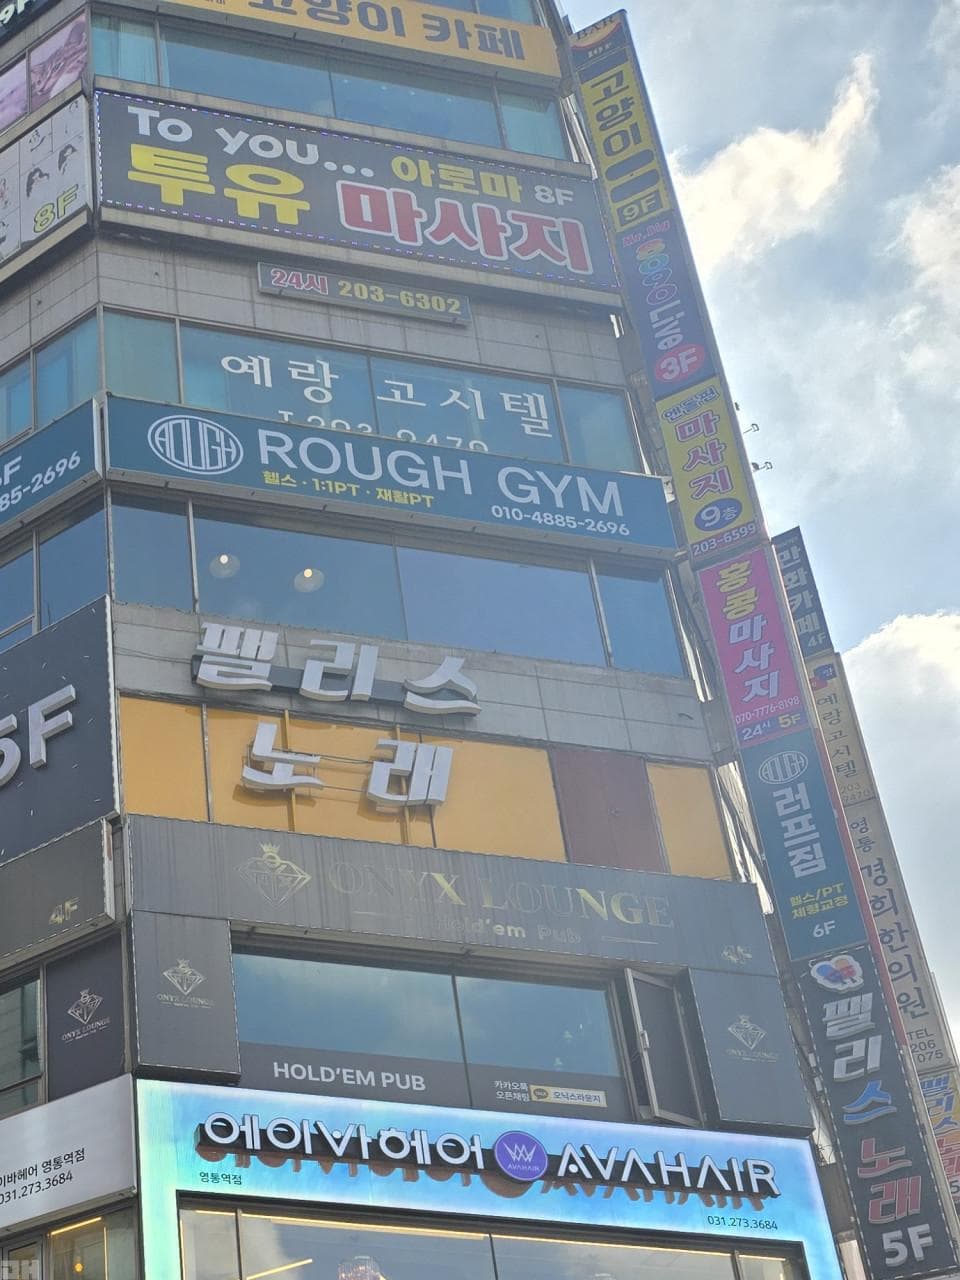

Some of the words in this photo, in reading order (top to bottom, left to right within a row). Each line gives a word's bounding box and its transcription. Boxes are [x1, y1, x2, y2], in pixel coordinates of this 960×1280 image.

[422, 13, 526, 60] 카페
[577, 15, 615, 41] BAR
[590, 70, 643, 158] 고양이
[128, 144, 310, 226] 투유
[392, 155, 523, 203] 아로마
[535, 184, 575, 207] 8F
[34, 184, 79, 233] 8F
[338, 179, 596, 276] 마사지
[622, 196, 657, 222] 9F
[271, 268, 328, 295] 24시
[339, 280, 462, 315] 203-6302
[658, 347, 699, 381] 3F
[221, 355, 339, 404] 예랑
[377, 377, 553, 440] 고시텔
[258, 429, 471, 497] ROUGH
[497, 466, 624, 517] GYM
[676, 410, 733, 501] 마사지
[263, 470, 297, 489] 헬스
[312, 478, 360, 497] 1:1PT
[376, 487, 434, 509] 재활PT
[491, 504, 631, 537] 010-4885-2696
[693, 521, 757, 556] 203-6599
[700, 503, 737, 529] 9층
[716, 560, 759, 622] 홍콩
[778, 544, 821, 635] 만화카페
[729, 614, 781, 703] 마사지
[807, 632, 827, 647] 4F
[197, 622, 482, 721] 팰리스
[742, 720, 772, 742] 24시
[779, 711, 801, 730] 5F
[816, 691, 857, 780] 예랑고시텔
[242, 722, 454, 807] 노래
[773, 783, 827, 878] 러프짐
[850, 816, 876, 854] 영통
[47, 898, 78, 927] 4F
[329, 858, 468, 908] ONYX
[483, 875, 676, 931] LOUNGE
[812, 920, 836, 938] 6F
[860, 857, 929, 1020] 경희한의원
[907, 1027, 933, 1041] TEL
[910, 1041, 936, 1054] 206
[273, 1061, 375, 1088] HOLD'EM
[382, 1073, 426, 1091] PUB
[823, 992, 897, 1126] 팰리스
[40, 1148, 87, 1178] 영통역점
[203, 1111, 484, 1171] 에이바헤어
[557, 1143, 780, 1197] AVAHAIR
[199, 1171, 243, 1186] 영통역점
[857, 1138, 923, 1225] 노래
[707, 1214, 779, 1232] 031.273.3684
[881, 1225, 935, 1266] 5F
